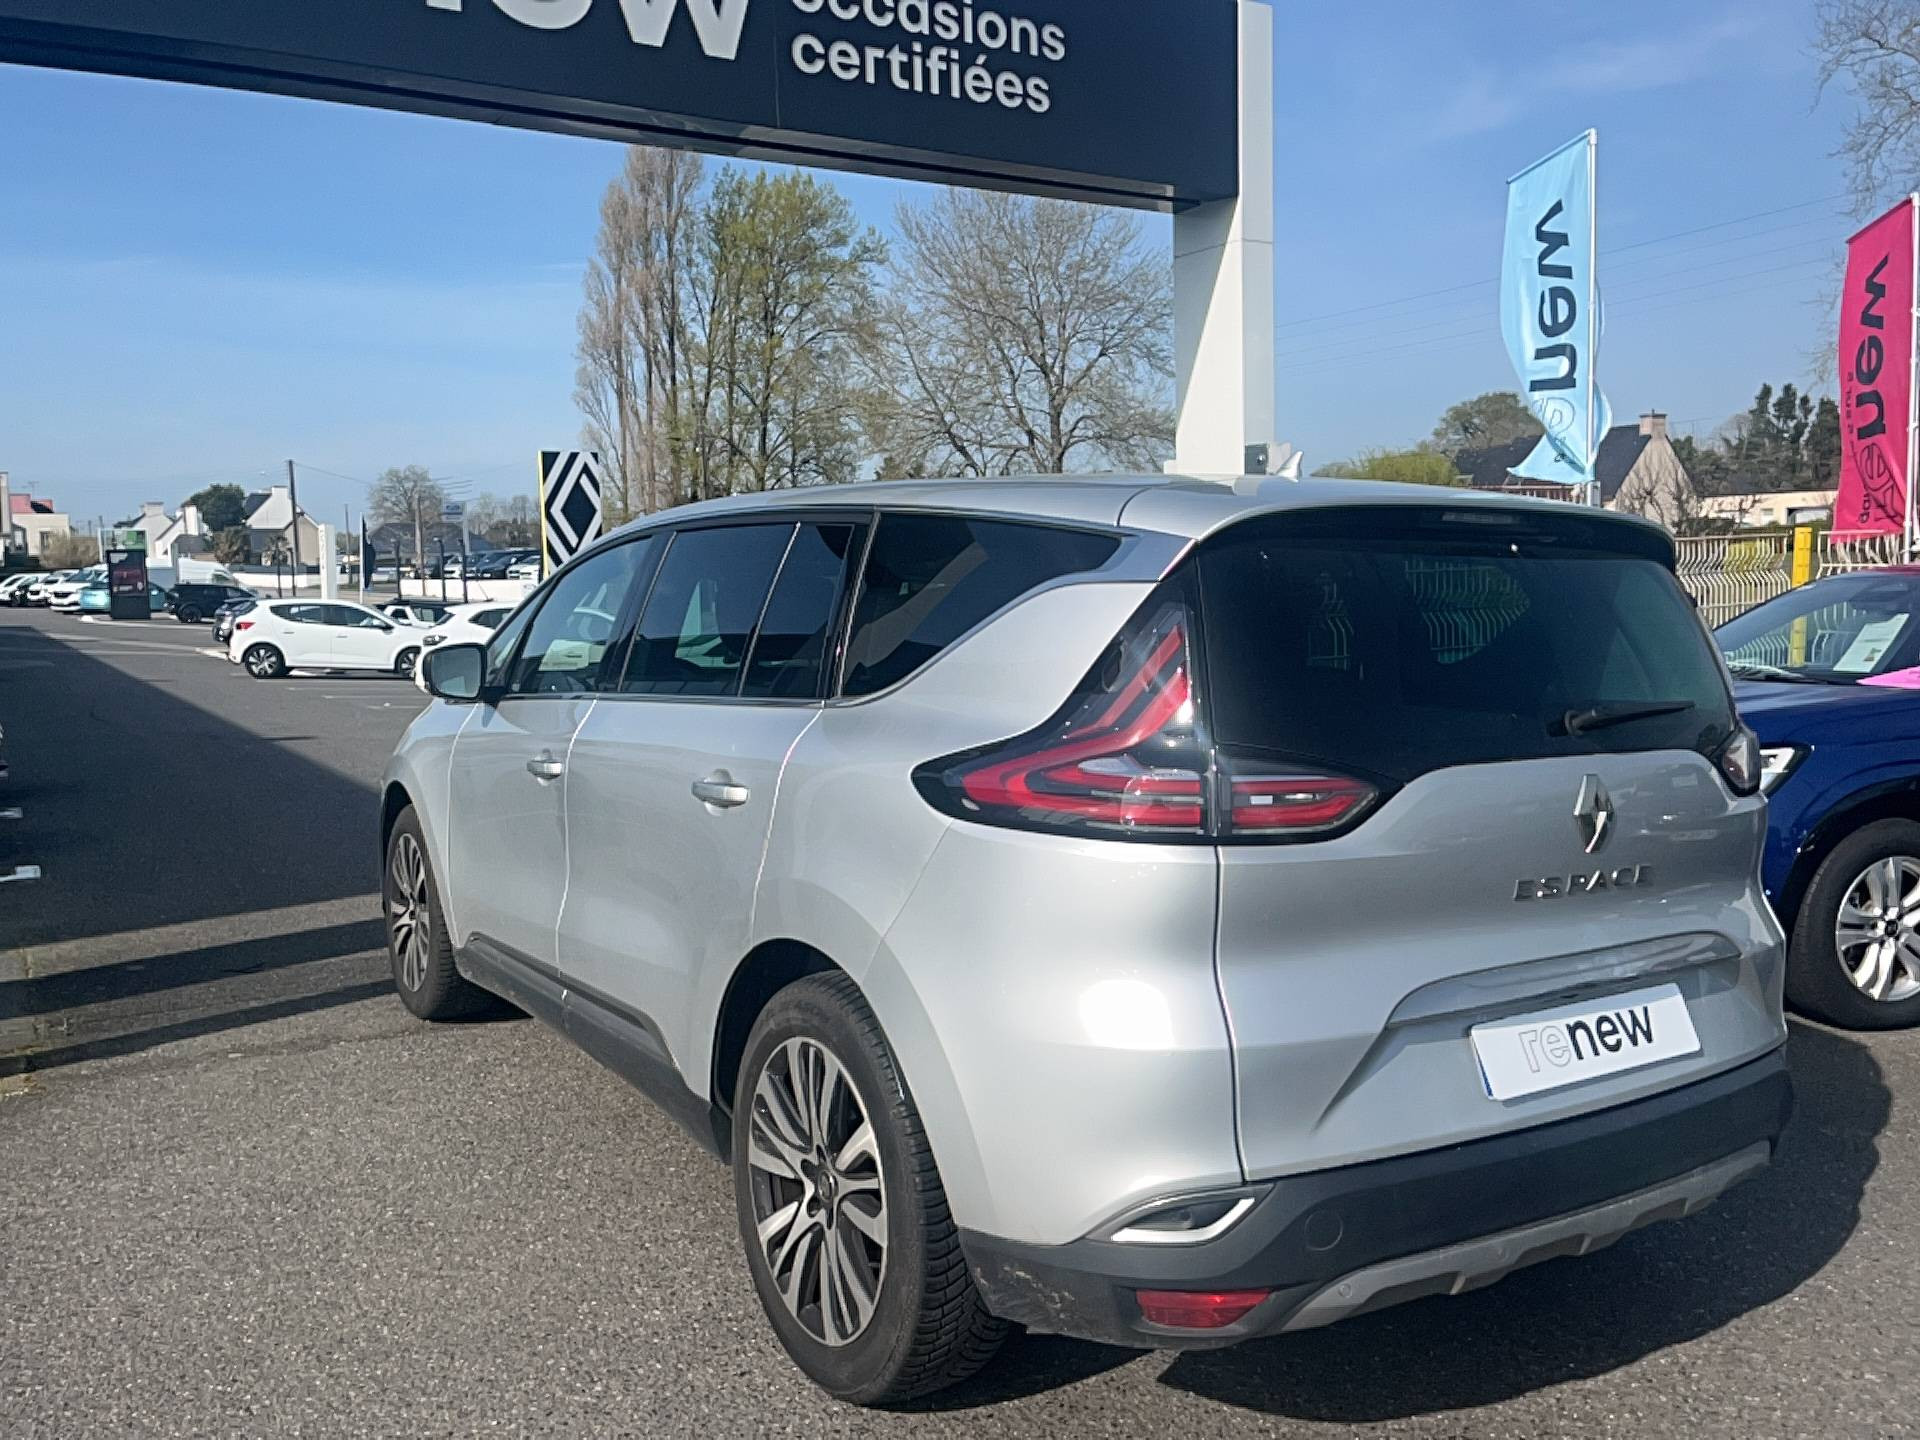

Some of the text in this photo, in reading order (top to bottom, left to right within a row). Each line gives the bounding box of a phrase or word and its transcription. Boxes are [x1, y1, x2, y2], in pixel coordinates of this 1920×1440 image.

[791, 33, 1051, 113] certifiées
[1512, 863, 1654, 901] ESPACE
[1518, 1005, 1654, 1074] renew
